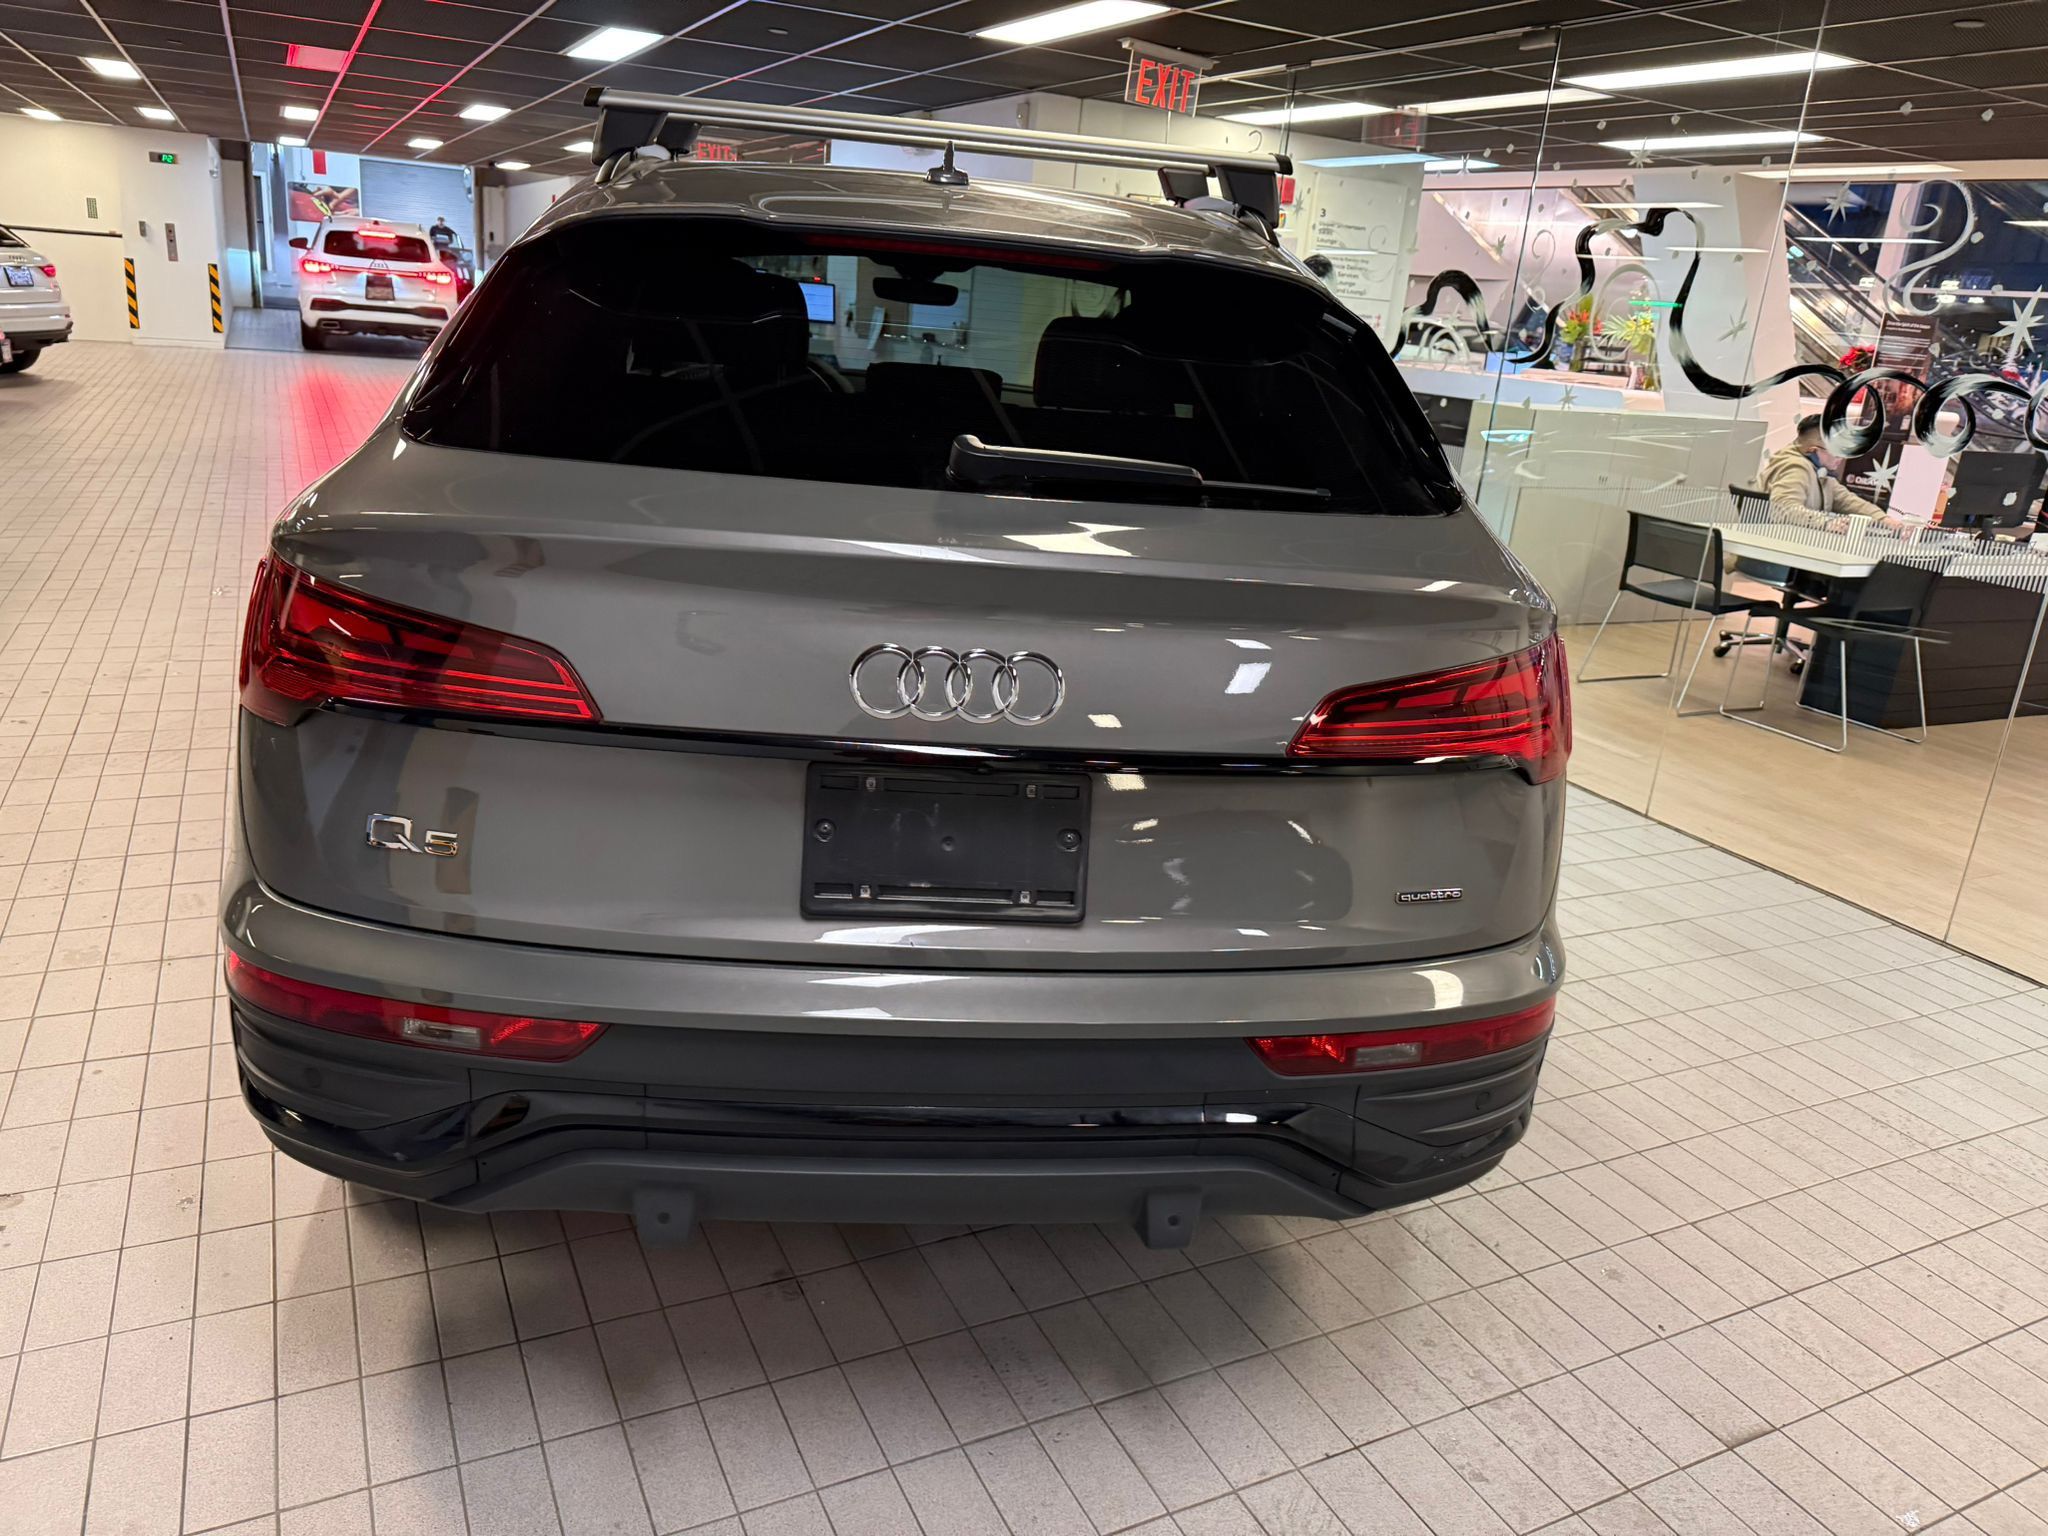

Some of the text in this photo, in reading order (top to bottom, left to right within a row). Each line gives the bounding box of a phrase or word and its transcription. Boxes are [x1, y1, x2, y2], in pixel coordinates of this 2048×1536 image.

[1135, 58, 1196, 113] EXIT
[697, 143, 731, 161] EXIT
[1320, 208, 1327, 218] 3
[366, 813, 459, 857] Q5
[1400, 890, 1461, 902] quattro
